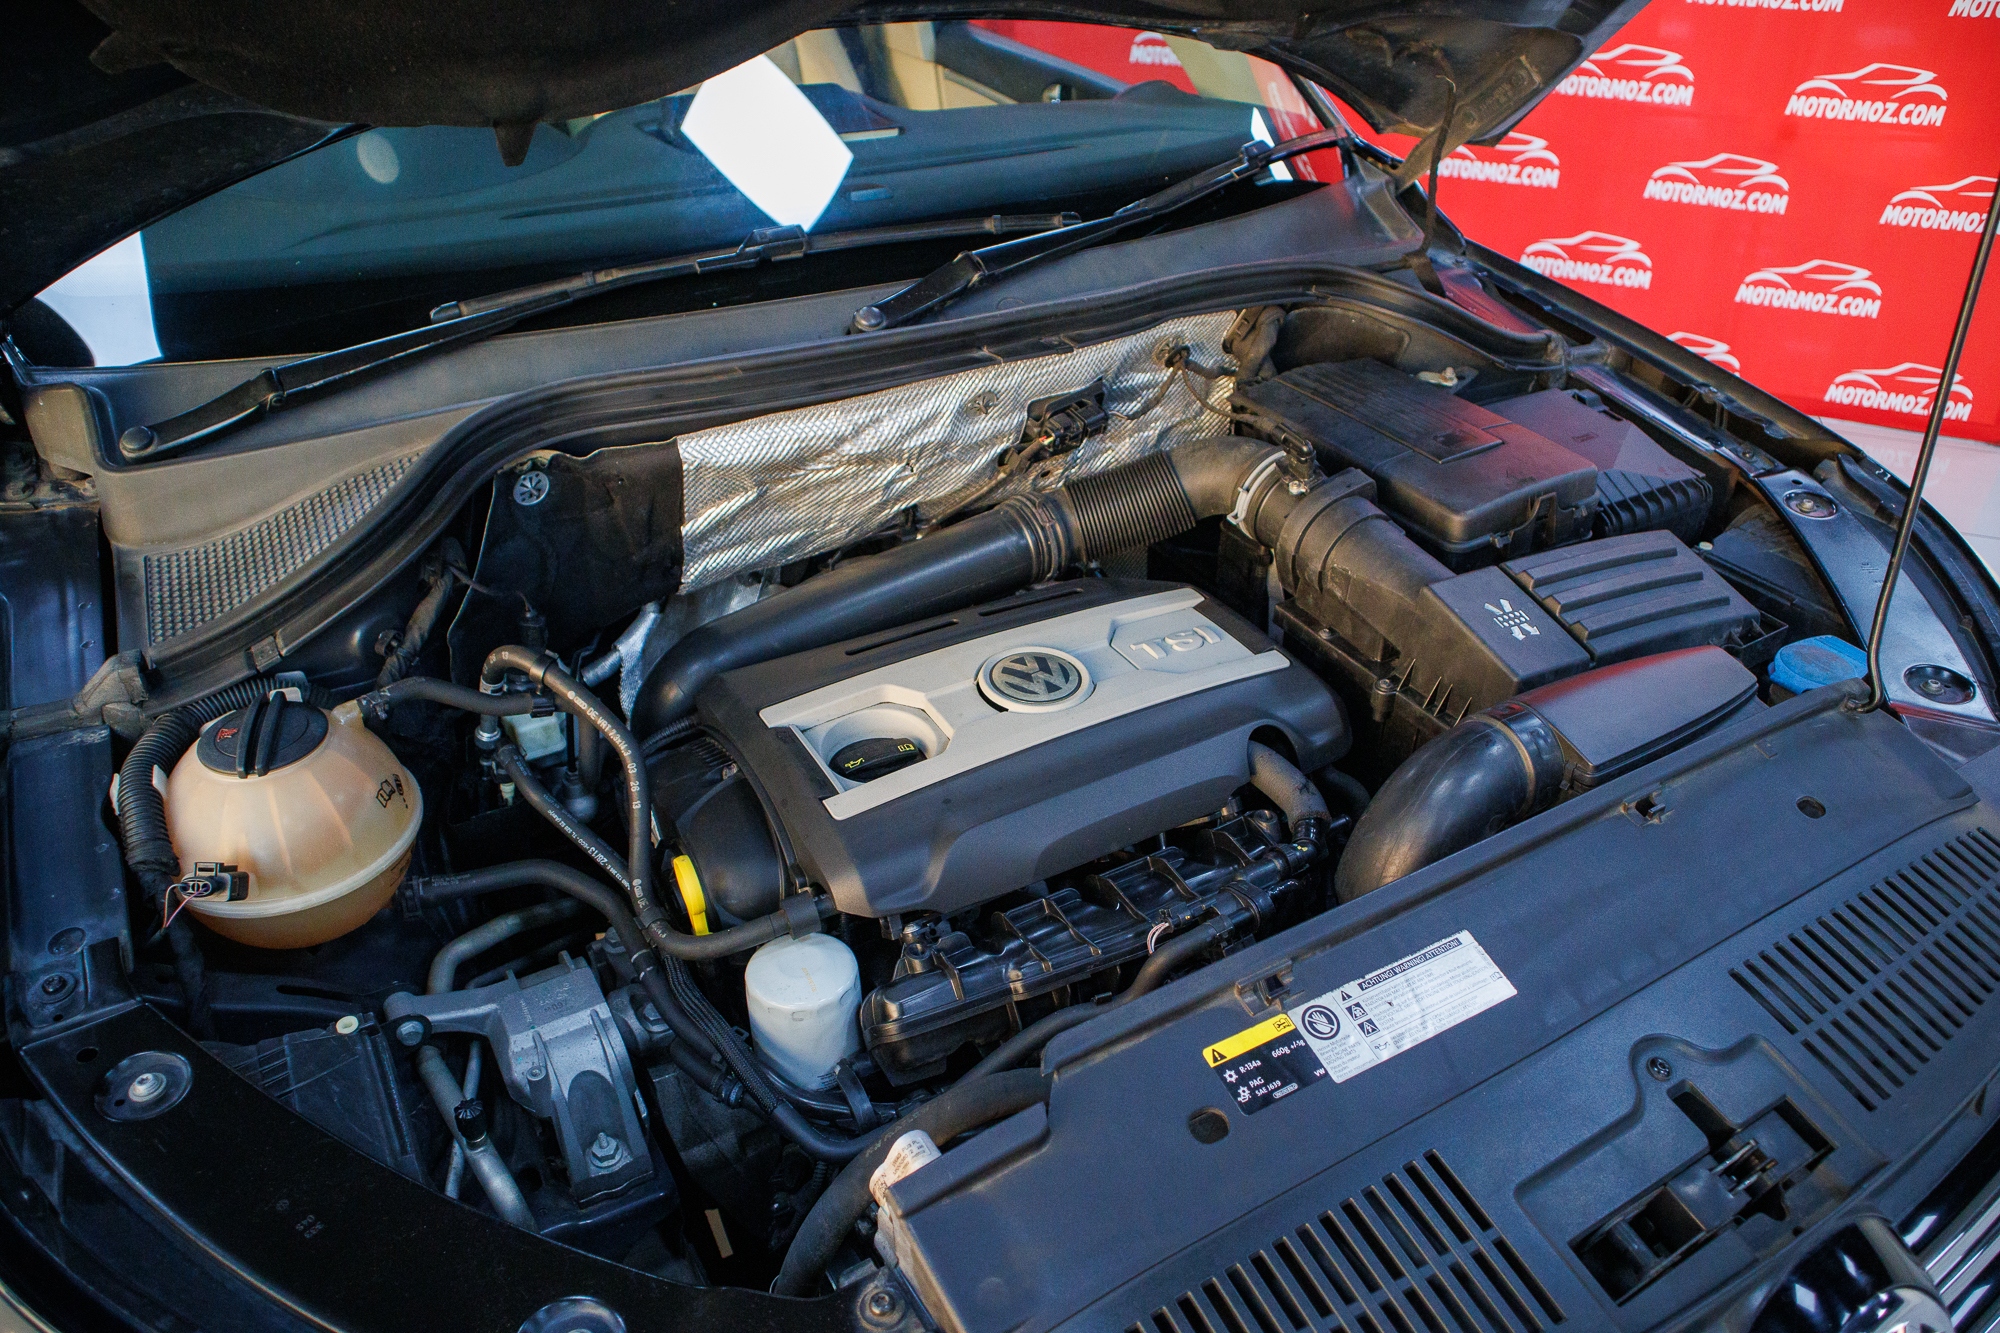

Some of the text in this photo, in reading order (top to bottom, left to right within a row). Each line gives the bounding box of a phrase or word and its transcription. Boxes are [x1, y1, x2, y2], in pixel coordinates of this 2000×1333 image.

[1784, 94, 1947, 126] MOTORMOZ.COM
[1427, 157, 1560, 188] OTORMOZ.COM
[1643, 178, 1789, 215] MOTORMOZ.COM
[1734, 283, 1882, 319] MOTORMOZ.COM
[1823, 384, 1973, 421] MOTORMOZ.OM
[1130, 625, 1221, 660] TSI
[597, 716, 612, 732] VRT
[630, 780, 640, 792] 26
[1360, 938, 1460, 989] ACHTUNG! WARNING! ATTENTION!
[1270, 1043, 1291, 1060] 660g
[1248, 1075, 1265, 1088] PAG
[1255, 1086, 1267, 1096] SAE
